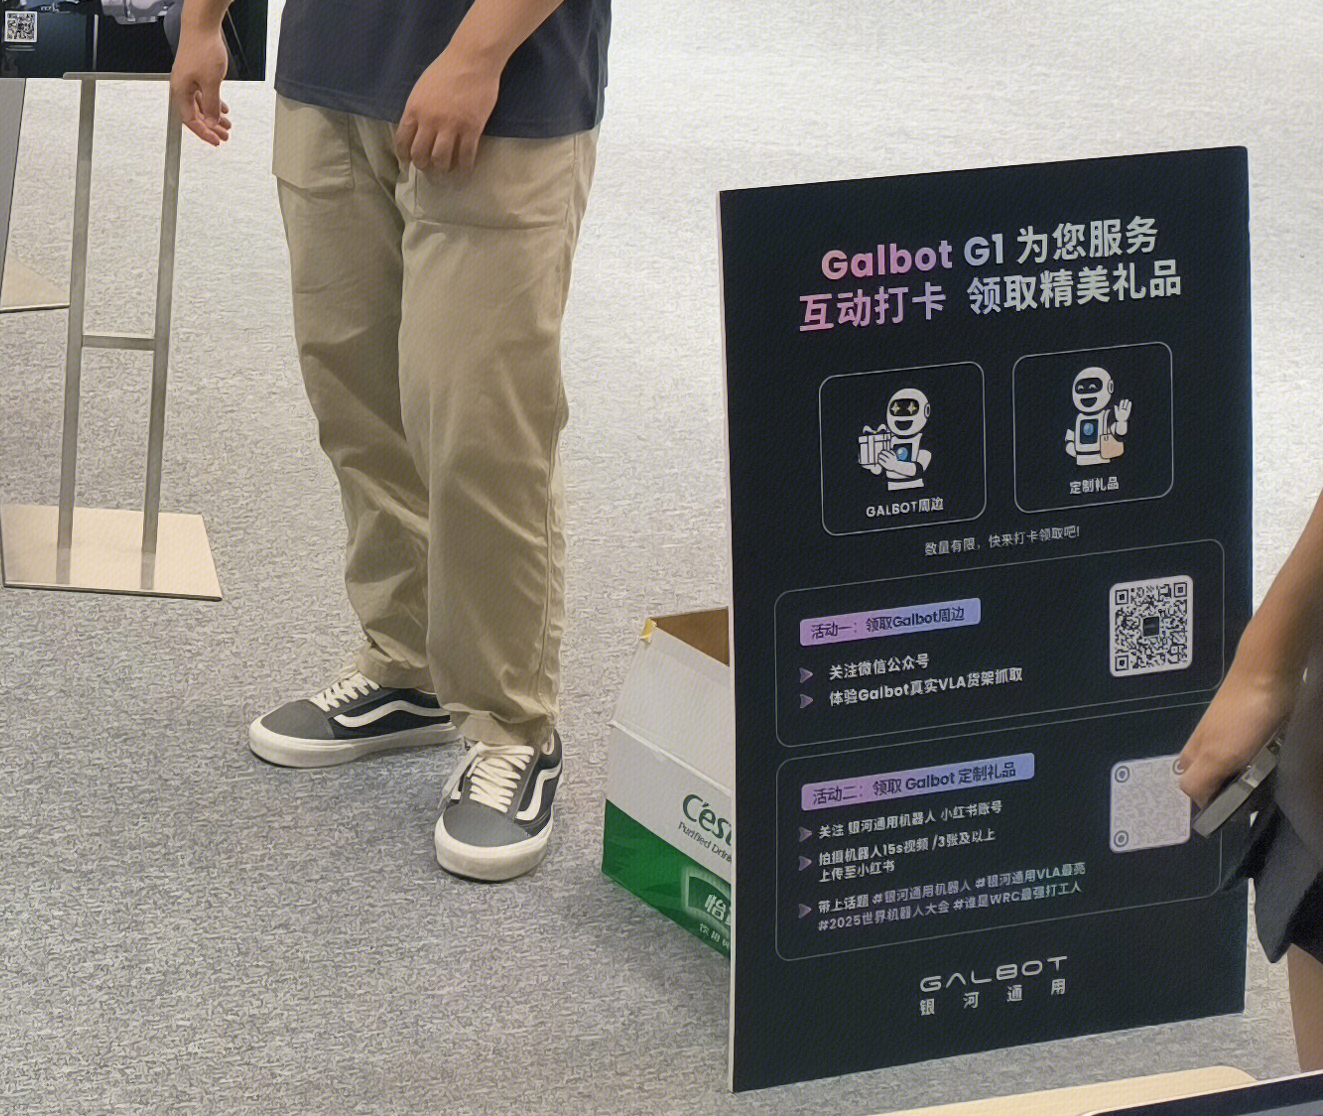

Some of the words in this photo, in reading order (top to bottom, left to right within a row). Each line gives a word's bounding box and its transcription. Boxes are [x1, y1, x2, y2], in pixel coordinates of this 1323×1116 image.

[821, 239, 953, 280] Galbot
[963, 233, 1004, 267] G1
[1016, 215, 1159, 265] 为您服务
[798, 281, 947, 332] 互动打卡
[966, 259, 1182, 315] 领取精美礼品
[1069, 476, 1120, 495] 定制礼品
[865, 496, 945, 519] GALBOT周边
[828, 652, 930, 681] 关注微信公众号
[828, 667, 1024, 707] 体验Galbot真实VLA货架抓取
[905, 771, 956, 791] Galbot
[957, 762, 1017, 785] 定制礼品
[678, 820, 712, 850] Purified
[818, 824, 845, 840] 关注
[848, 808, 937, 836] 银河通用机器人
[940, 799, 1003, 822] 小红书账号
[818, 859, 896, 884] 上传至小红书
[704, 893, 732, 927] 怡
[817, 893, 870, 915] 带上话题
[871, 879, 972, 905] #银河通用机器人
[817, 899, 950, 932] #2025世界机器人大会
[952, 880, 1083, 911] #谁是WRC最强打工人
[919, 955, 1068, 993] GALBOT
[919, 978, 1067, 1017] 银河通用
